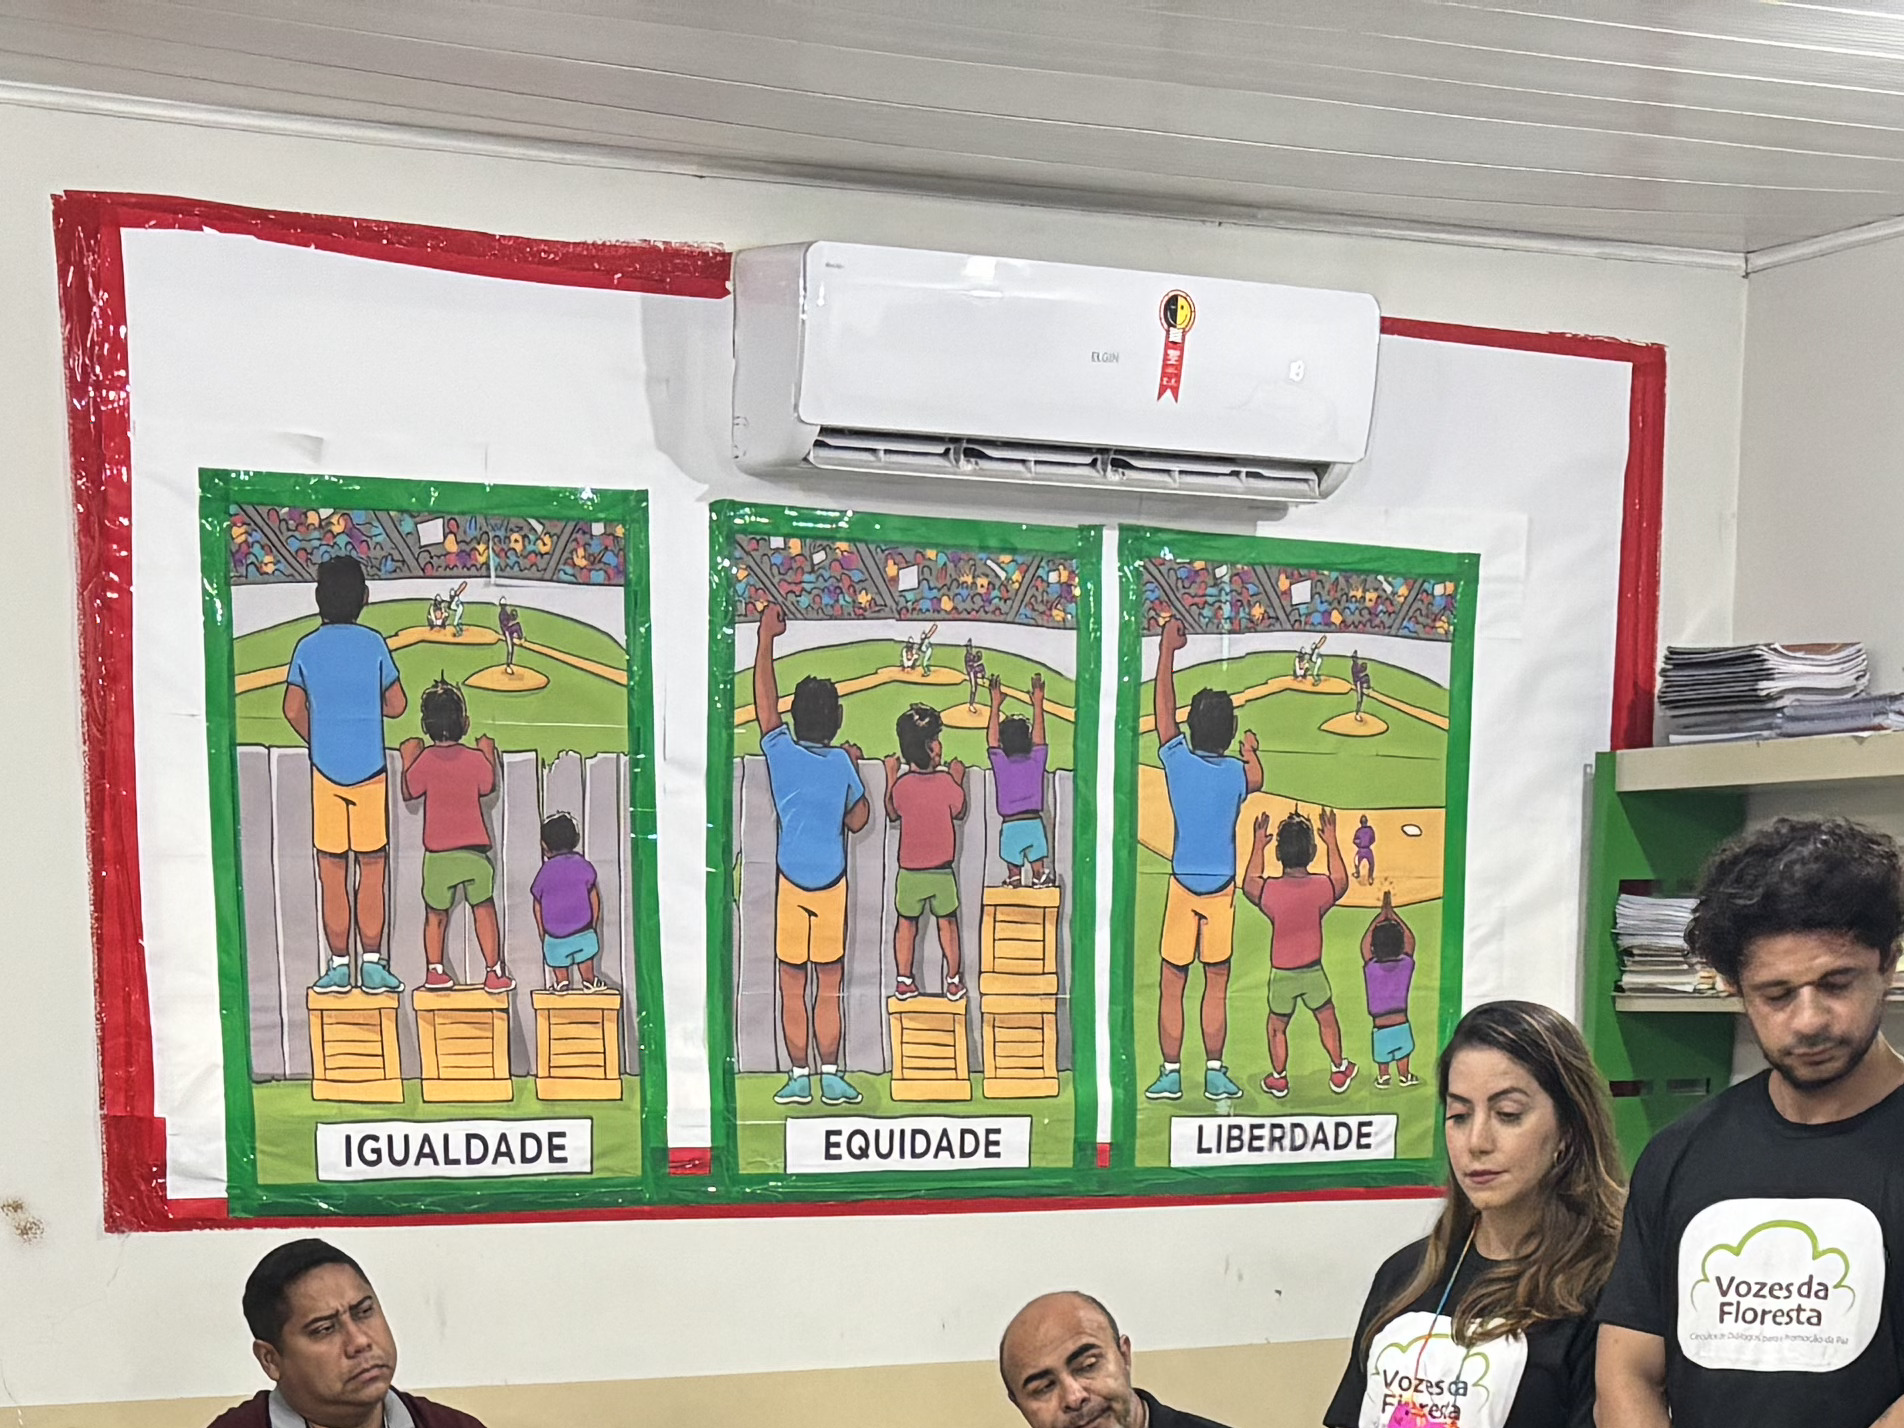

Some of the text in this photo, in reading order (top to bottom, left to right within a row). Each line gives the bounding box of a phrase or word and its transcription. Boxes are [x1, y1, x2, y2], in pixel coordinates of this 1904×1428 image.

[345, 1132, 568, 1167] IGUALDADE
[825, 1128, 1001, 1160] EQUIDADE
[1197, 1121, 1373, 1154] LIBERDADE
[1715, 1274, 1829, 1300] Vozes da
[1719, 1301, 1822, 1326] Floresta
[1383, 1369, 1445, 1395] Vozes
